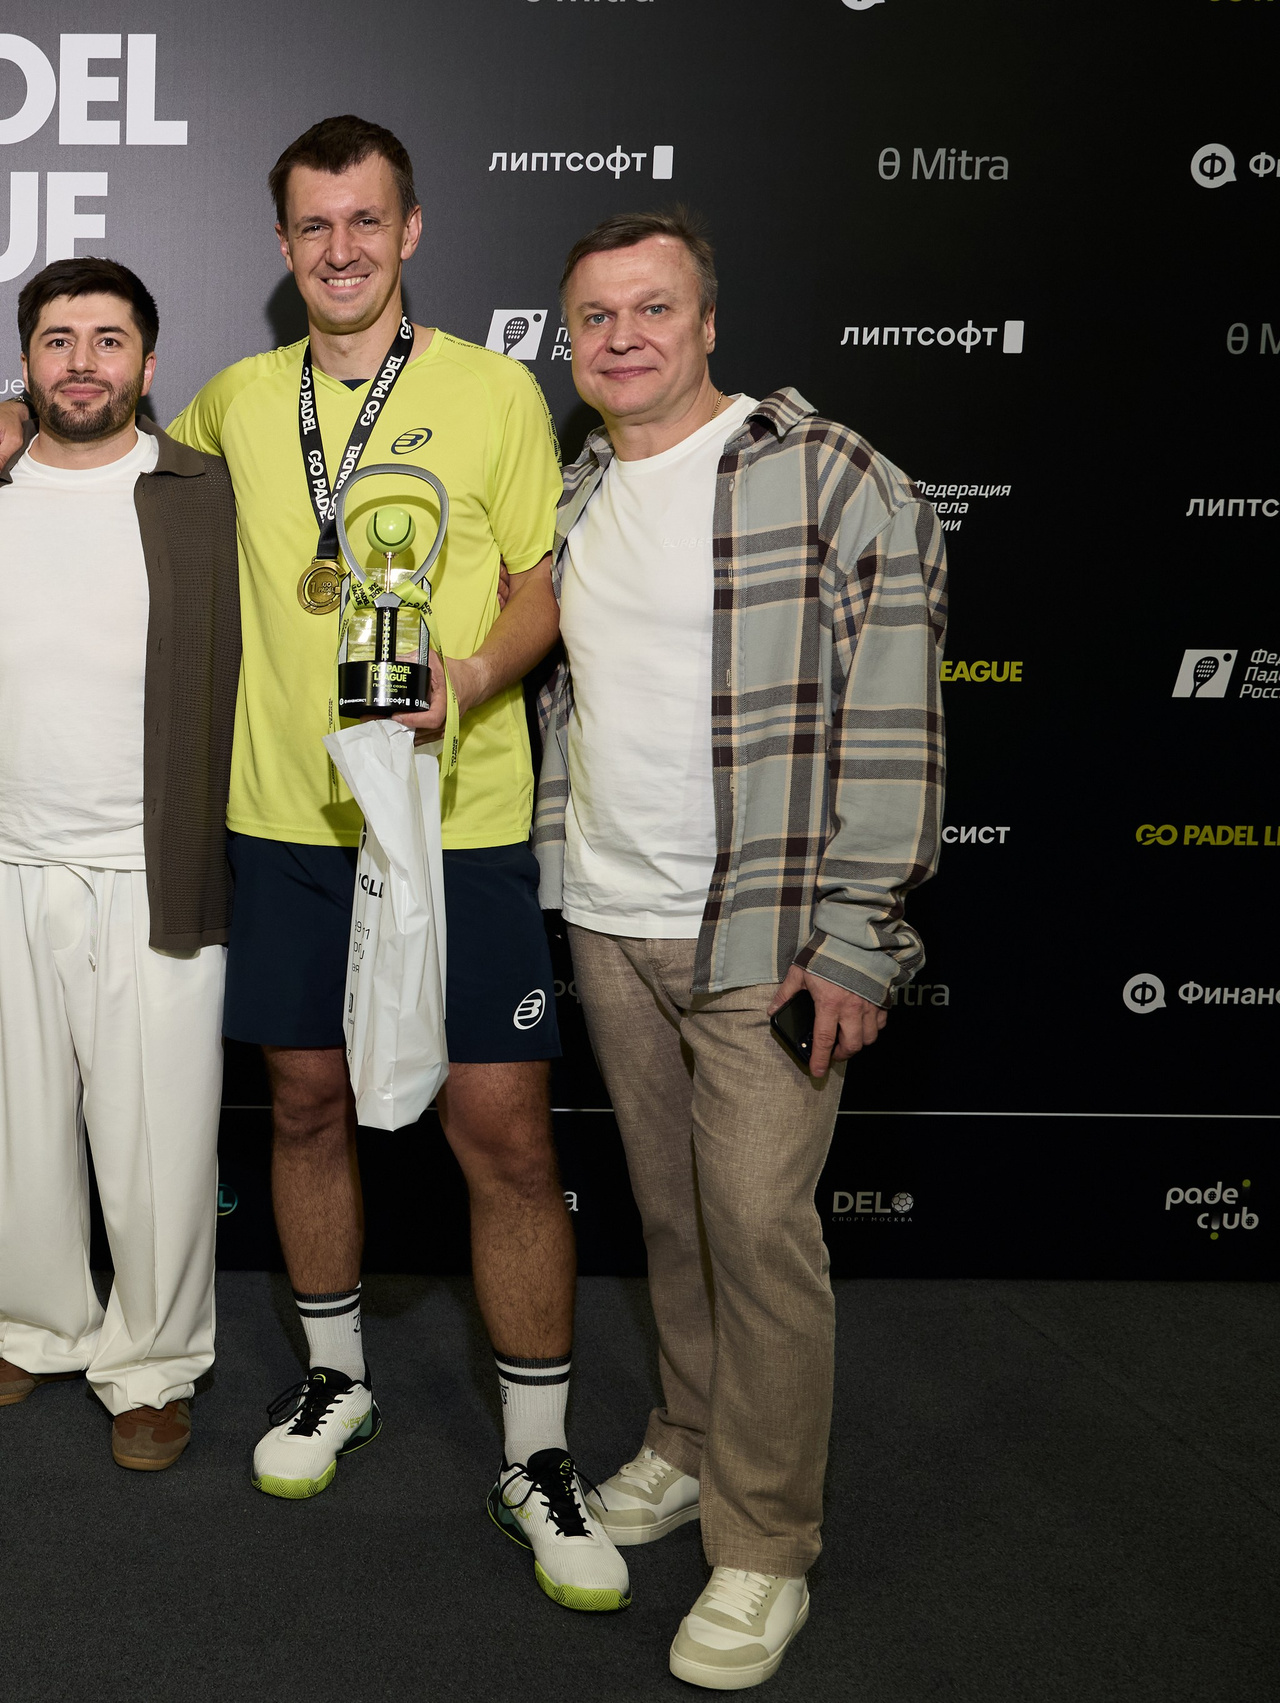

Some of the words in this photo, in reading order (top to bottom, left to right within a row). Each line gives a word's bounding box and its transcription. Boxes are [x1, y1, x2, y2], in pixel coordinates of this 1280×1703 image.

[489, 145, 647, 179] липтсофт
[912, 148, 1008, 180] Mitra
[841, 320, 998, 353] липтсофт
[374, 354, 405, 399] PADEL
[300, 391, 317, 436] PADEL
[1186, 499, 1280, 517] липтс
[1239, 684, 1280, 698] Росс
[1245, 667, 1280, 683] Пад
[1136, 824, 1178, 846] GO
[1184, 825, 1259, 846] PADEL
